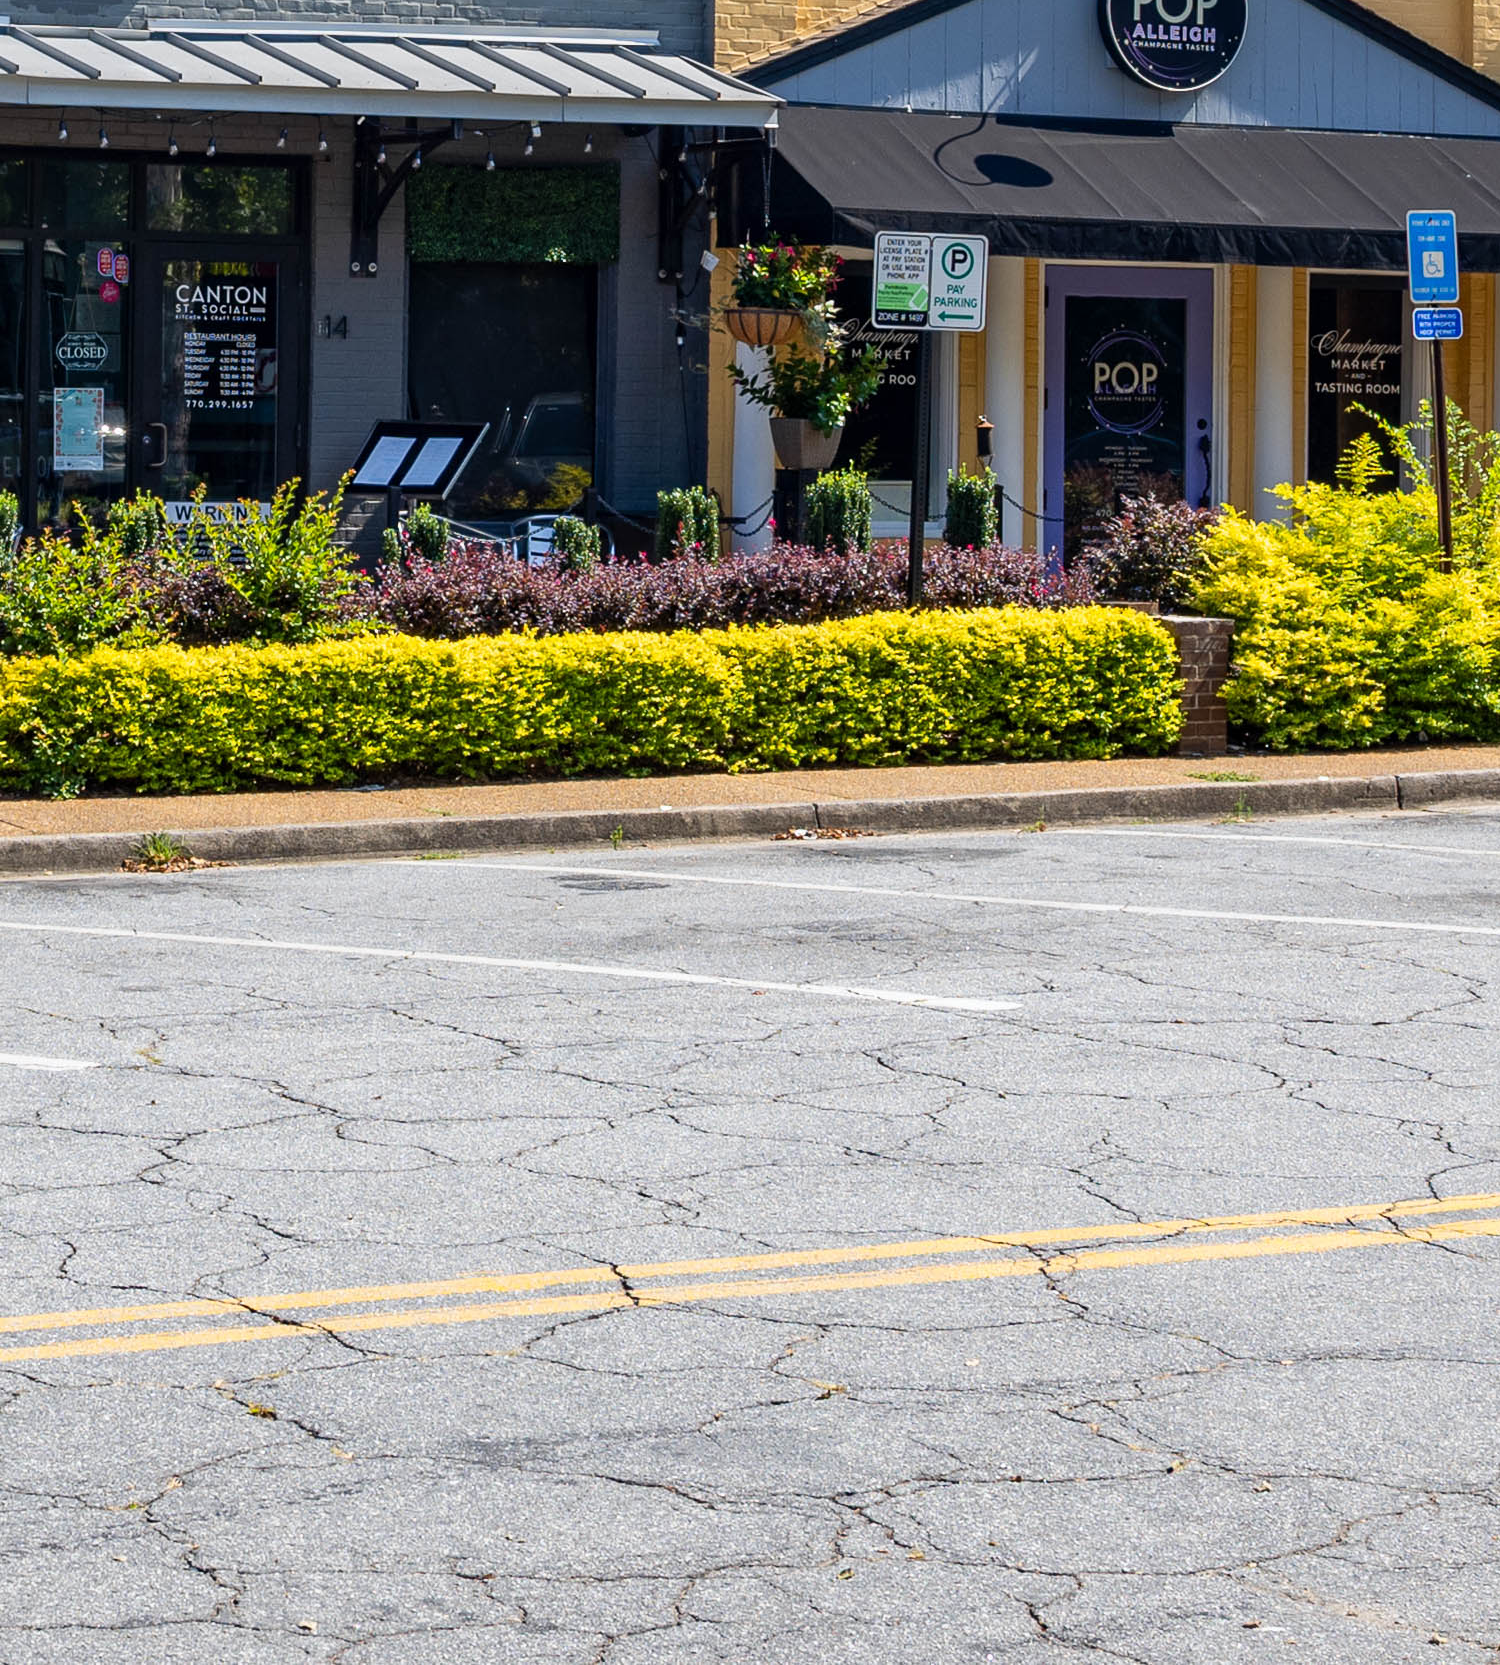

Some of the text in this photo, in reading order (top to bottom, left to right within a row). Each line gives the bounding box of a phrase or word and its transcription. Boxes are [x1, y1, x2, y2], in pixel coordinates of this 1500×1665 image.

[1132, 22, 1216, 43] ALLEIGH
[1133, 40, 1216, 52] CHAMPAGNE TASTES
[907, 239, 922, 247] YOUR
[880, 247, 903, 255] LICENSE
[951, 249, 968, 272] P
[176, 284, 267, 305] CANTON
[946, 284, 966, 295] PAY
[934, 296, 978, 308] PARKING
[175, 303, 248, 315] ST. SOCIAL
[877, 312, 899, 321] ZONE
[58, 346, 106, 359] CLOSED
[1311, 329, 1403, 364] Champagne
[851, 348, 911, 361] MRKET
[1331, 359, 1386, 370] MARKET
[889, 374, 917, 385] ROO
[1094, 361, 1158, 394] POP
[1315, 382, 1400, 395] TASTING ROOM
[186, 399, 254, 409] 770.299.1657
